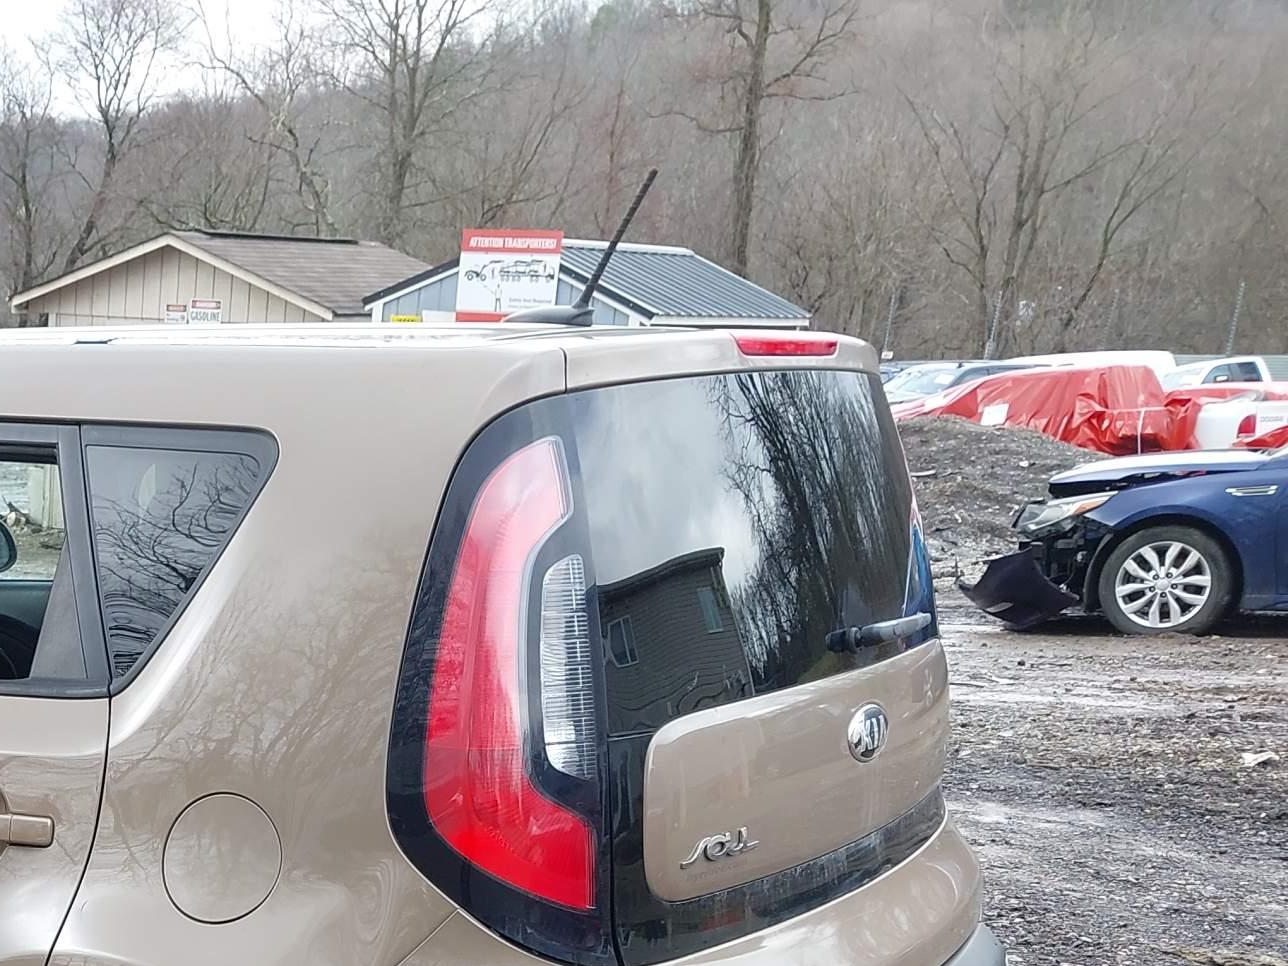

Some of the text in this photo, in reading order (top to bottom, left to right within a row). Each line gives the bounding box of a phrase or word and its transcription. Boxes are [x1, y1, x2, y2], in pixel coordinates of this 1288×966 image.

[469, 236, 504, 248] ATTENTION
[190, 310, 221, 322] GASOLINE
[860, 714, 888, 752] KIA
[679, 827, 760, 869] SOUL
